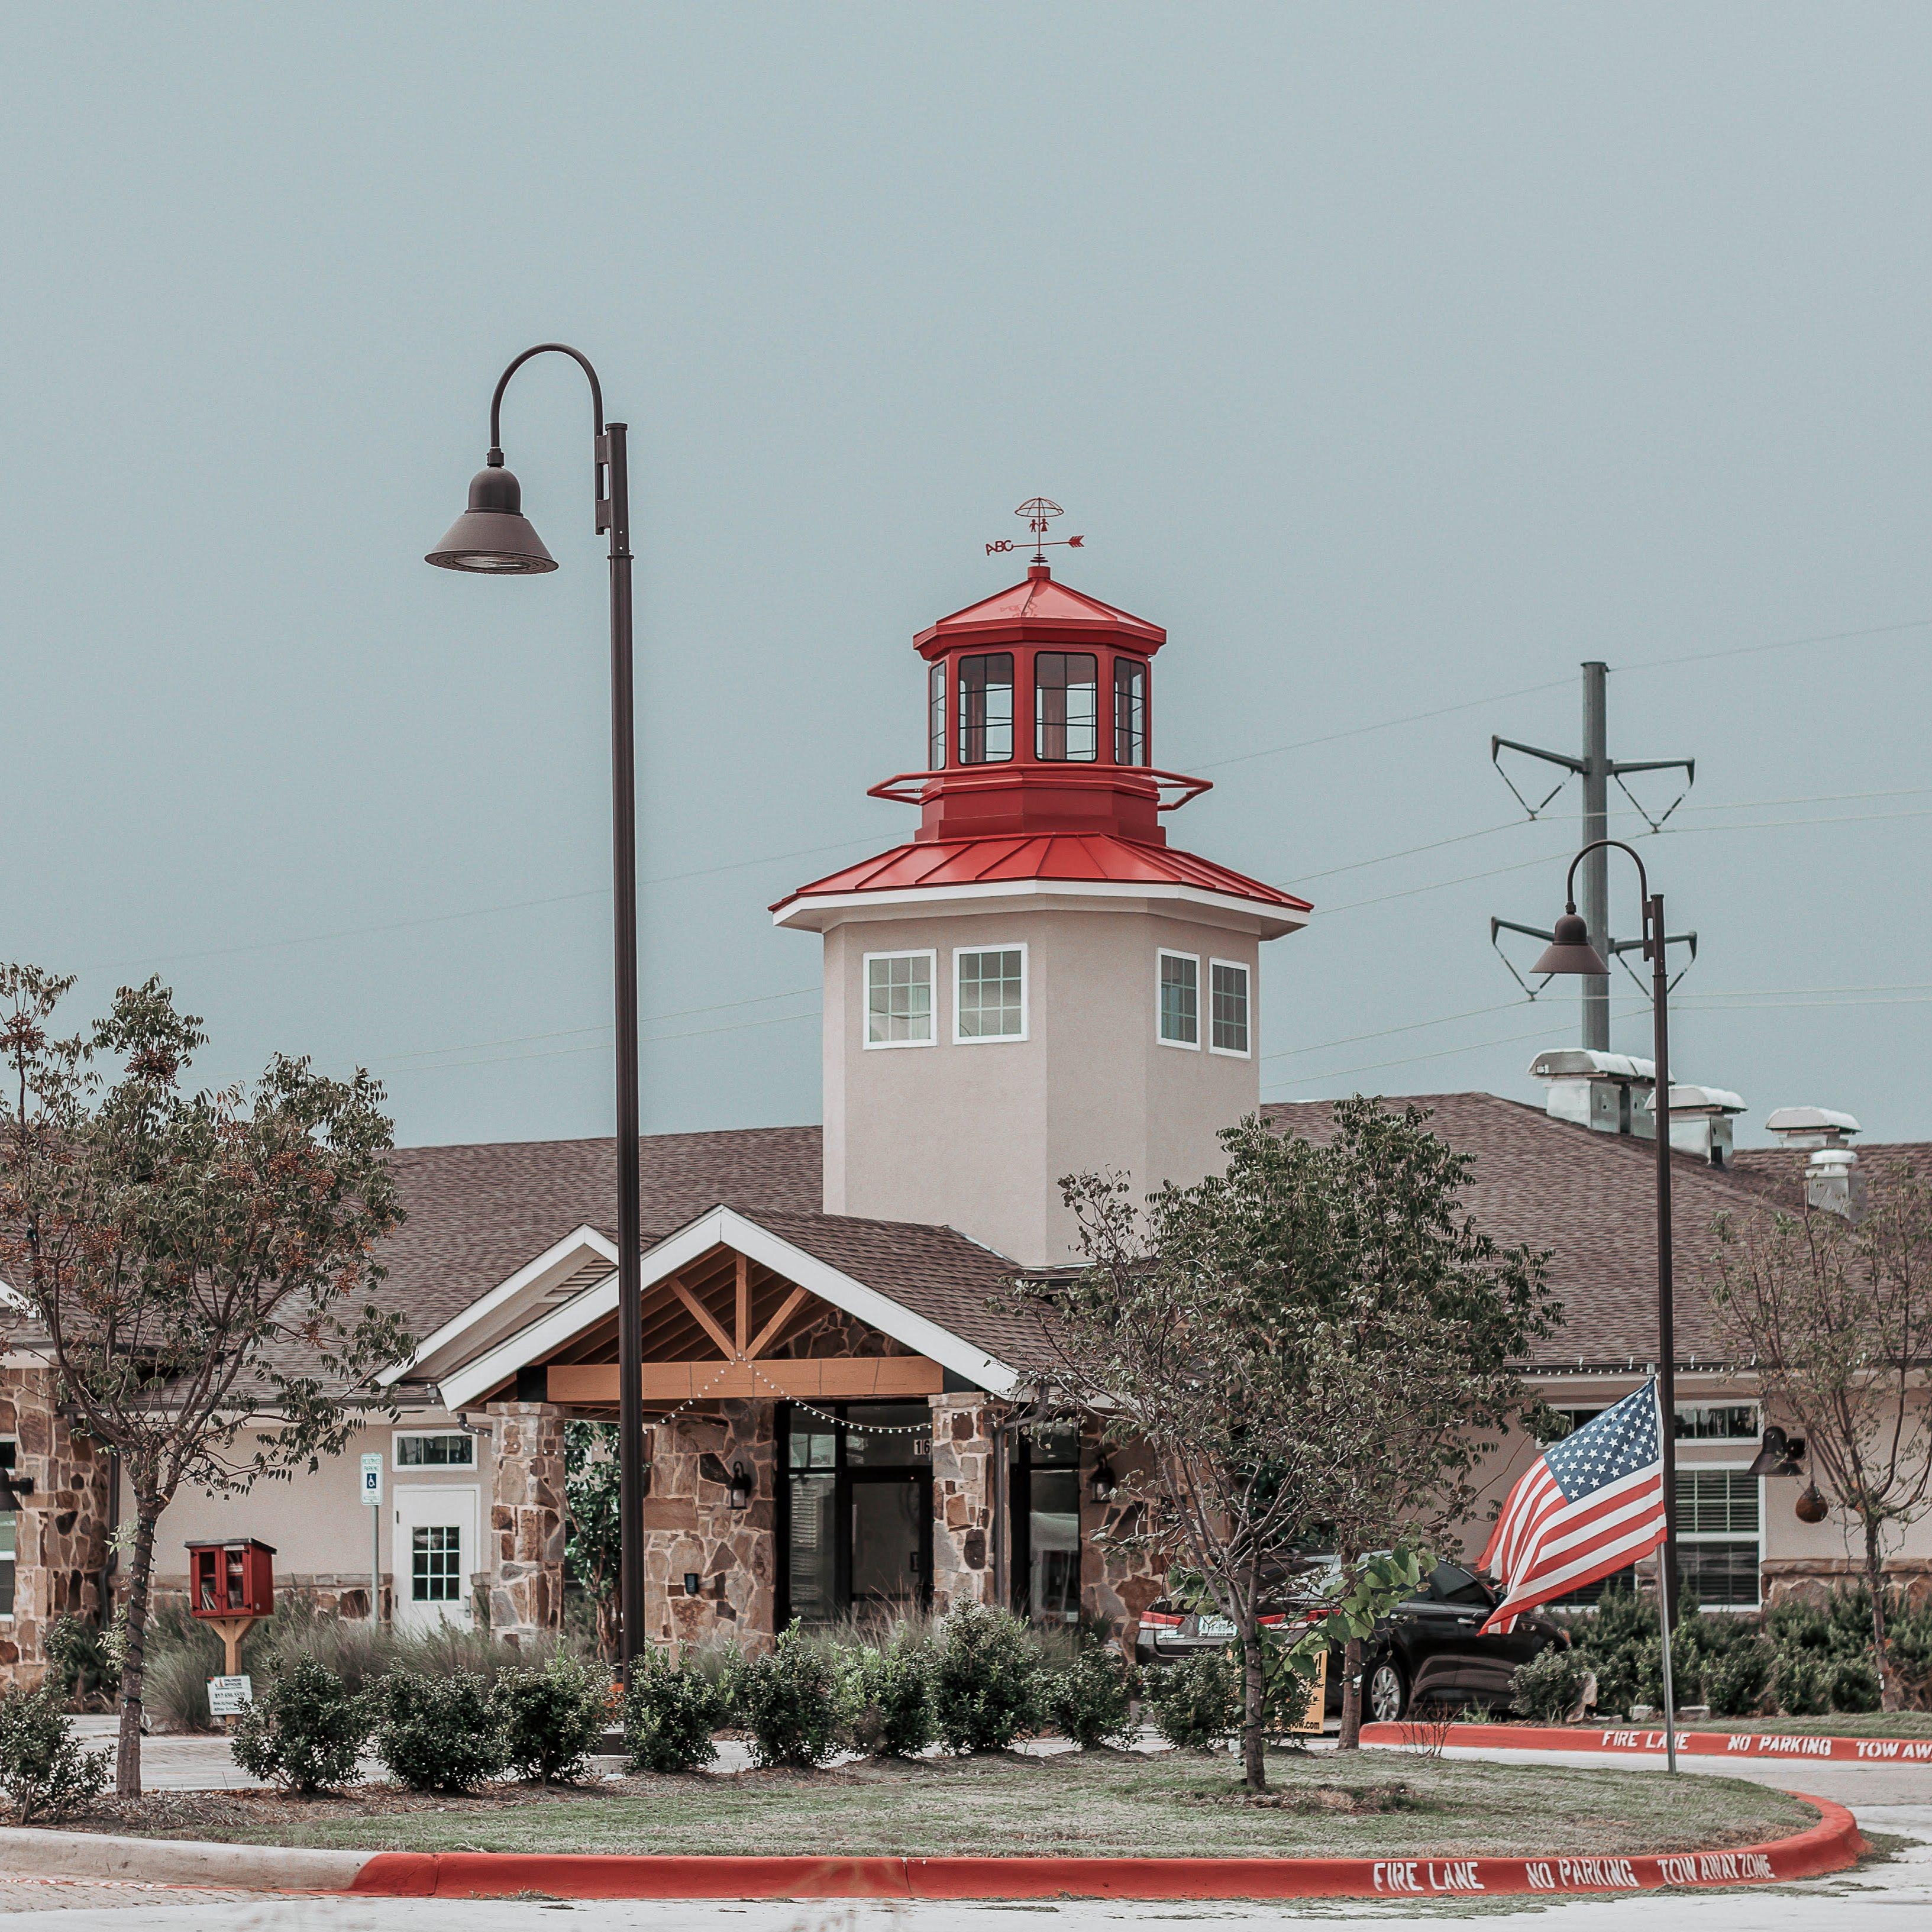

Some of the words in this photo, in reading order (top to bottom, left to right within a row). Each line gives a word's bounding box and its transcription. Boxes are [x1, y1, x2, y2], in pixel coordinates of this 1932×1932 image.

[986, 539, 1013, 556] ABC
[1601, 1730, 1641, 1747] FIRE
[1727, 1735, 1752, 1752] NO
[1758, 1736, 1832, 1756] PARKING
[1856, 1742, 1900, 1757] TOW
[1901, 1743, 1932, 1759] AW
[1374, 1862, 1424, 1892] FIRE
[1429, 1862, 1485, 1890] LANE
[1525, 1862, 1555, 1889] NO
[1558, 1859, 1640, 1887] PARKING
[1657, 1856, 1698, 1884] TOW
[1700, 1854, 1739, 1881] AWAY
[1737, 1853, 1775, 1879] ZONE
